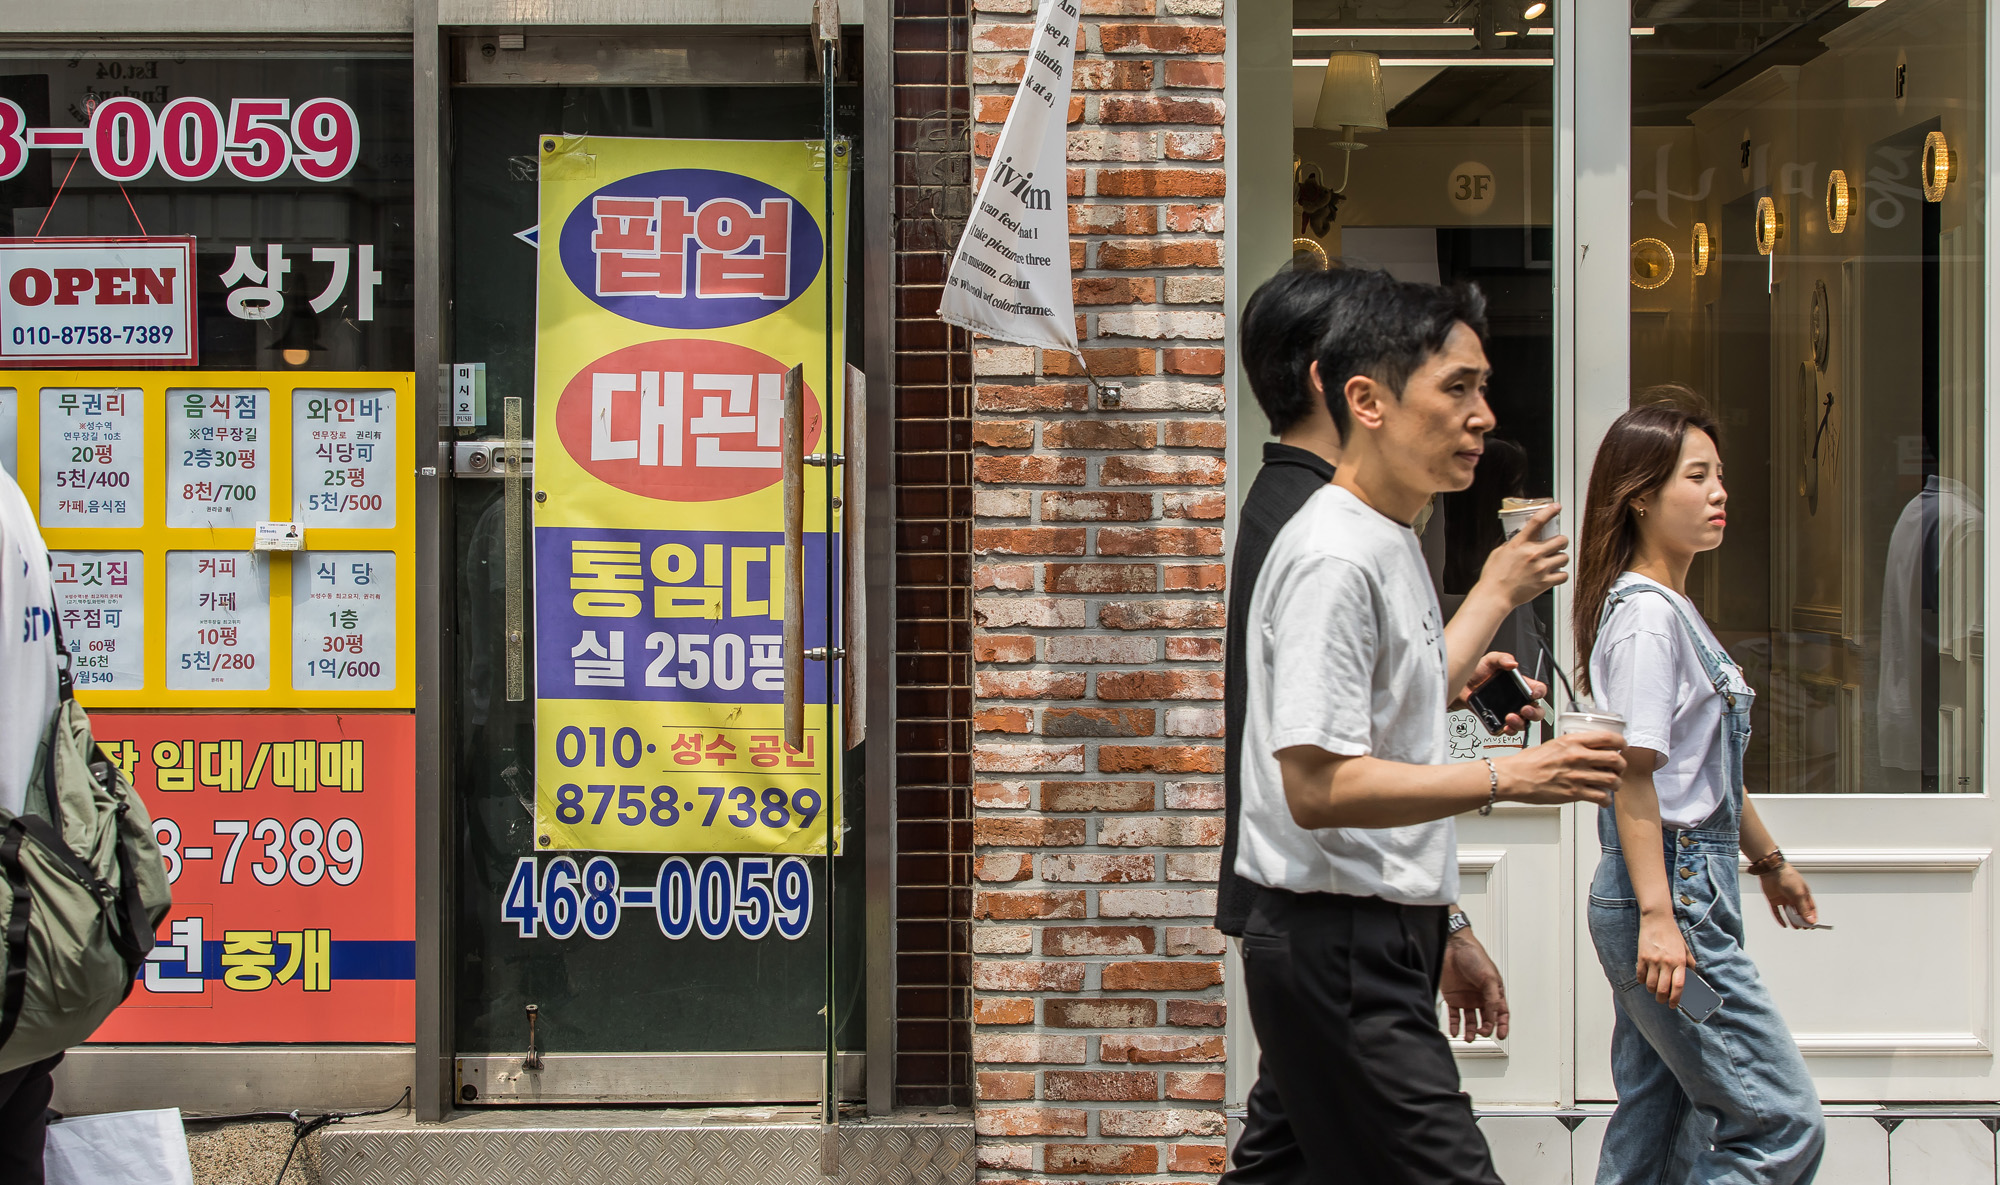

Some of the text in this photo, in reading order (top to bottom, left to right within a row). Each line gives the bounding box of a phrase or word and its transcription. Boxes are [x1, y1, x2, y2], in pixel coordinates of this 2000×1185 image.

[1455, 174, 1491, 200] 3F
[998, 212, 1021, 233] feel
[592, 196, 793, 301] 팝업
[1025, 253, 1051, 266] three
[8, 267, 177, 307] OPEN
[12, 326, 174, 346] 010-8758-7389
[458, 368, 470, 412] 미시오
[58, 393, 125, 417] 무권리
[183, 393, 257, 420] 음식점
[306, 398, 383, 423] 와인바
[591, 371, 784, 468] 대관
[63, 432, 122, 442] 연무장길 10초
[71, 444, 113, 465] 20평
[183, 447, 256, 470] 2층30평
[315, 442, 375, 463] 식당可
[56, 468, 131, 490] 5천/400
[323, 467, 365, 488] 25평
[182, 481, 257, 502] 8천/700
[308, 491, 383, 513] 5천/500
[59, 499, 127, 514] 카페,음식점
[54, 560, 128, 587] 고깃집
[198, 557, 237, 578] 커피
[199, 591, 237, 612] 카페
[62, 608, 123, 630] 주점可
[329, 608, 359, 630] 1층
[69, 639, 116, 652] 실 60평
[197, 626, 238, 647] 10평
[322, 633, 363, 655] 30평
[76, 655, 109, 668] 보6천
[181, 650, 256, 672] 5천/280
[307, 658, 381, 680] 1억/600
[571, 629, 626, 688] 실
[670, 732, 737, 767] 성수
[748, 735, 816, 768] 공인
[151, 739, 365, 793] 임대/매매
[151, 817, 365, 887] 8-7389
[501, 856, 814, 942] 468-0059
[220, 928, 332, 992] 중개
